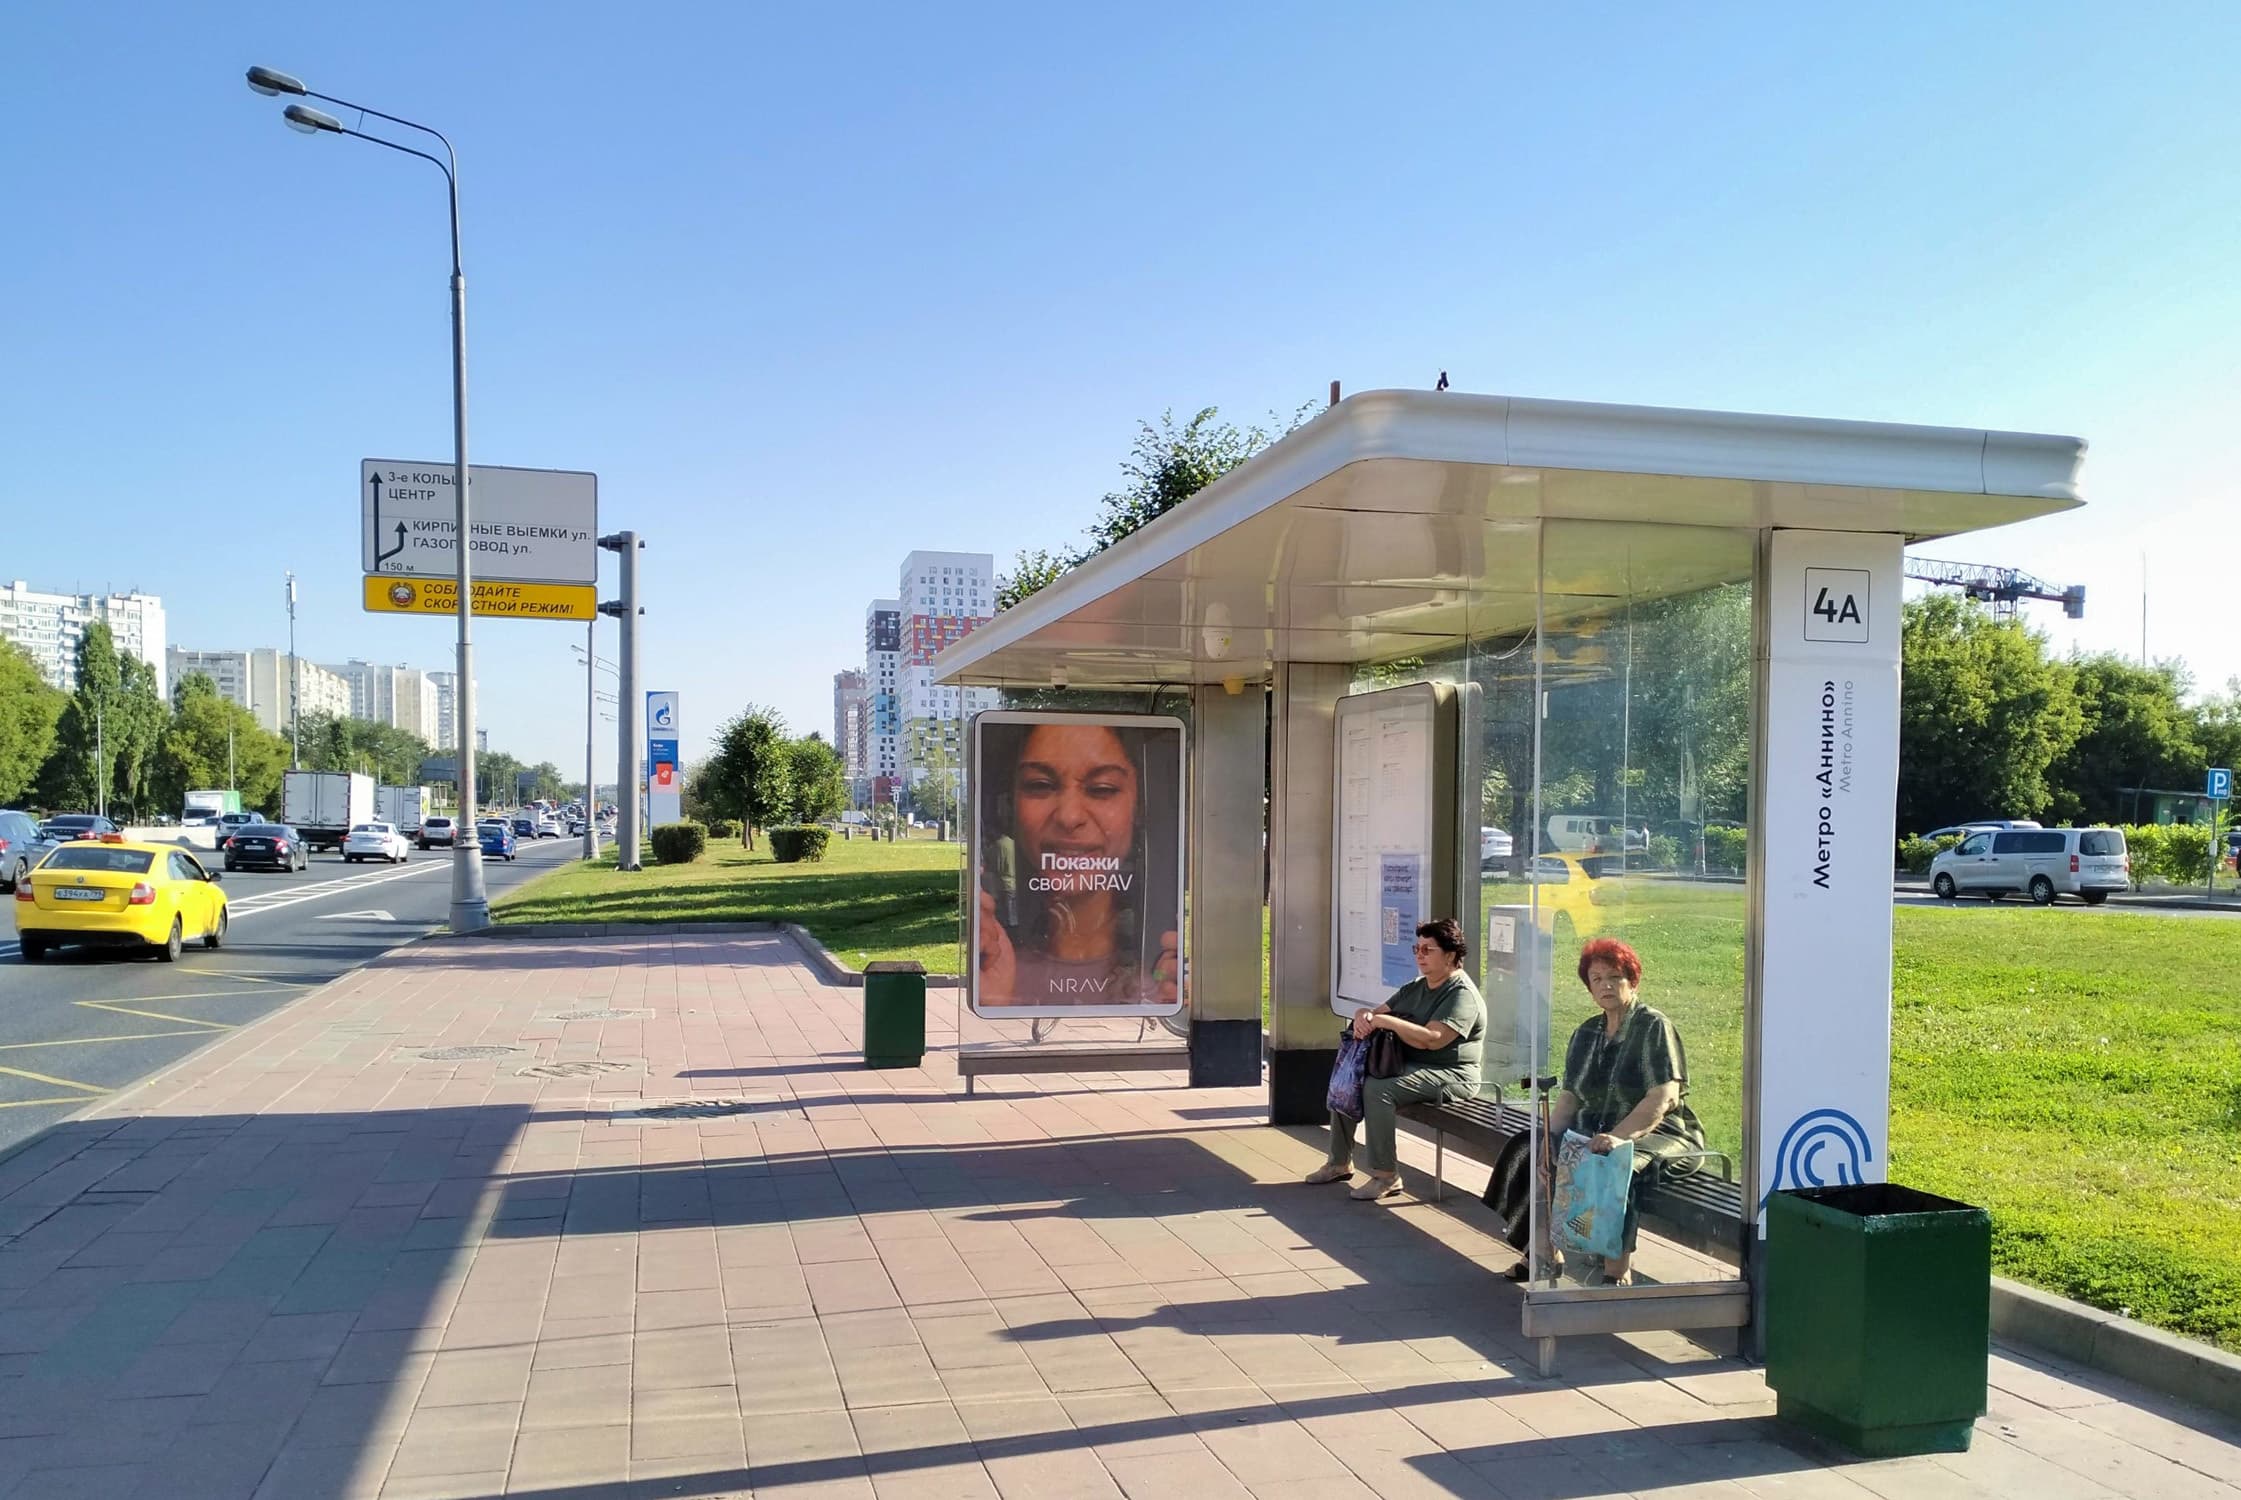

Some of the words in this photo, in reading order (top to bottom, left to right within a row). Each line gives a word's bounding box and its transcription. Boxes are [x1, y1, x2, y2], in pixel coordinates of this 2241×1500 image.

[388, 471, 409, 483] 3-е
[412, 472, 472, 486] КОЛЬ
[388, 487, 436, 501] ЦЕНТР
[412, 520, 502, 536] КИРПИНЫЕ
[506, 525, 568, 539] ВЫЕМКИ
[571, 531, 591, 542] ул.
[413, 537, 509, 554] ГАЗОПОВОД
[512, 544, 533, 556] ул.
[384, 562, 403, 571] 150
[405, 564, 415, 572] м
[423, 598, 517, 612] СКОРСТНОЙ
[519, 602, 575, 615] РЕЖИМ!
[1812, 587, 1862, 625] 4А
[1842, 680, 1854, 739] Annino
[1816, 680, 1835, 799] «Аннино»
[1840, 743, 1854, 793] Metro
[2213, 772, 2227, 796] P
[1813, 806, 1835, 889] Метро
[1041, 852, 1120, 871] Покажи
[1028, 873, 1074, 892] свой
[1079, 873, 1134, 892] NRAV
[1049, 978, 1110, 993] NRAV
